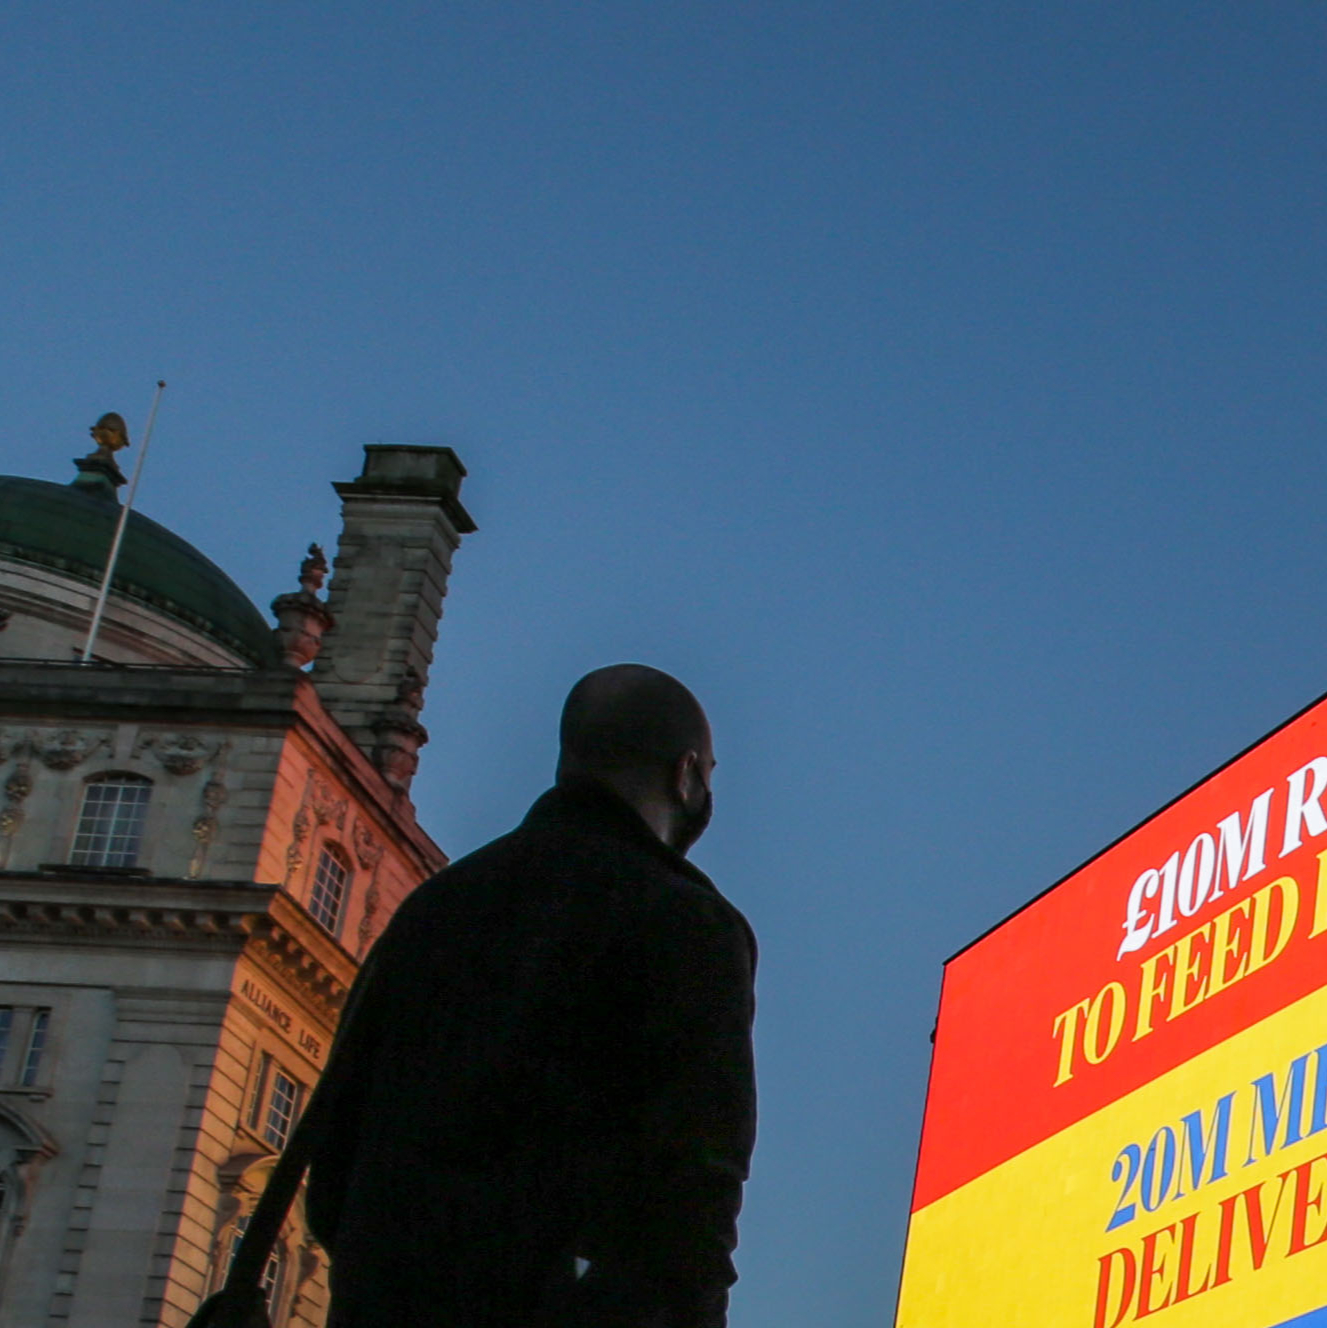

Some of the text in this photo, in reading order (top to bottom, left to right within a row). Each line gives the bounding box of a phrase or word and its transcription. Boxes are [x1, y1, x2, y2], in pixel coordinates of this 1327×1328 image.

[1116, 787, 1276, 962] £10M
[241, 979, 321, 1060] ALLIANCE LIFE
[1052, 980, 1127, 1088] TO
[1131, 876, 1300, 1042] FEED
[1105, 1092, 1237, 1232] 20M
